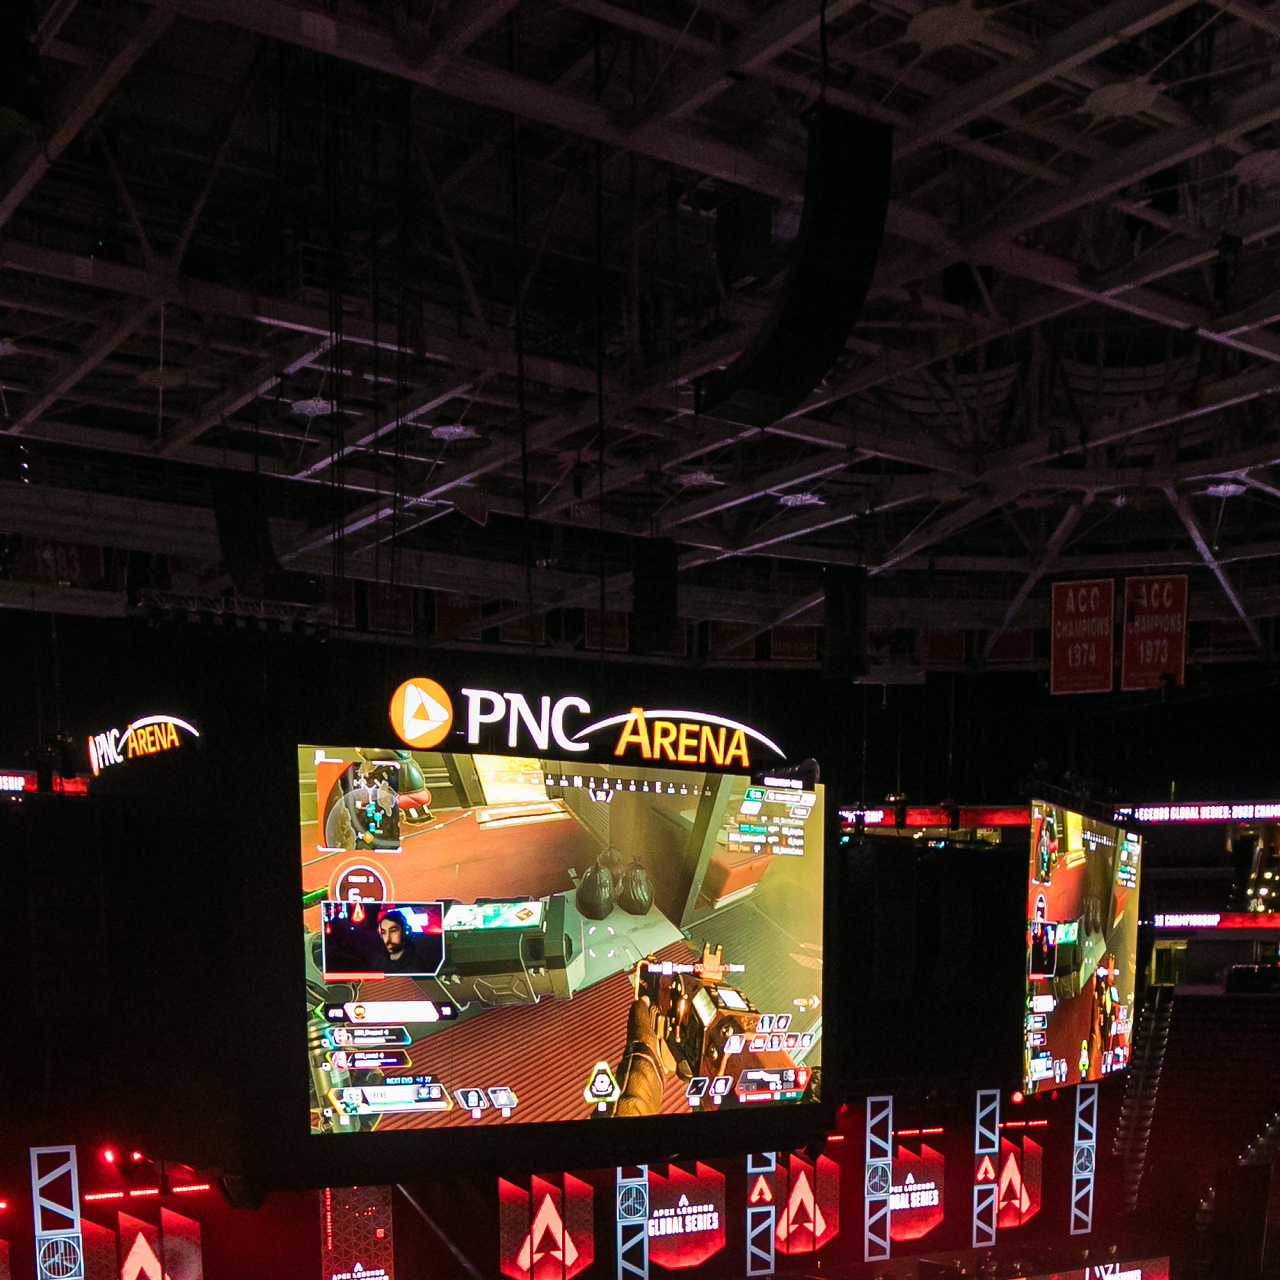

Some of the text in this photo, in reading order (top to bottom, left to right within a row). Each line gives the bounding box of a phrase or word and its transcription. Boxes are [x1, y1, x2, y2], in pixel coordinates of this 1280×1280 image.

[1066, 587, 1100, 614] ACC
[1056, 617, 1110, 639] CHAMPIONS
[461, 688, 750, 768] PNC ARENA
[94, 722, 180, 768] PNC ARENA
[573, 775, 662, 793] N E
[1232, 805, 1254, 818] 2022
[1164, 914, 1220, 926] CHAMPIONSHIP
[910, 1190, 939, 1208] SERIES
[653, 1204, 714, 1218] APEX LEGENDS
[648, 1212, 719, 1237] GLOBAL SERIES
